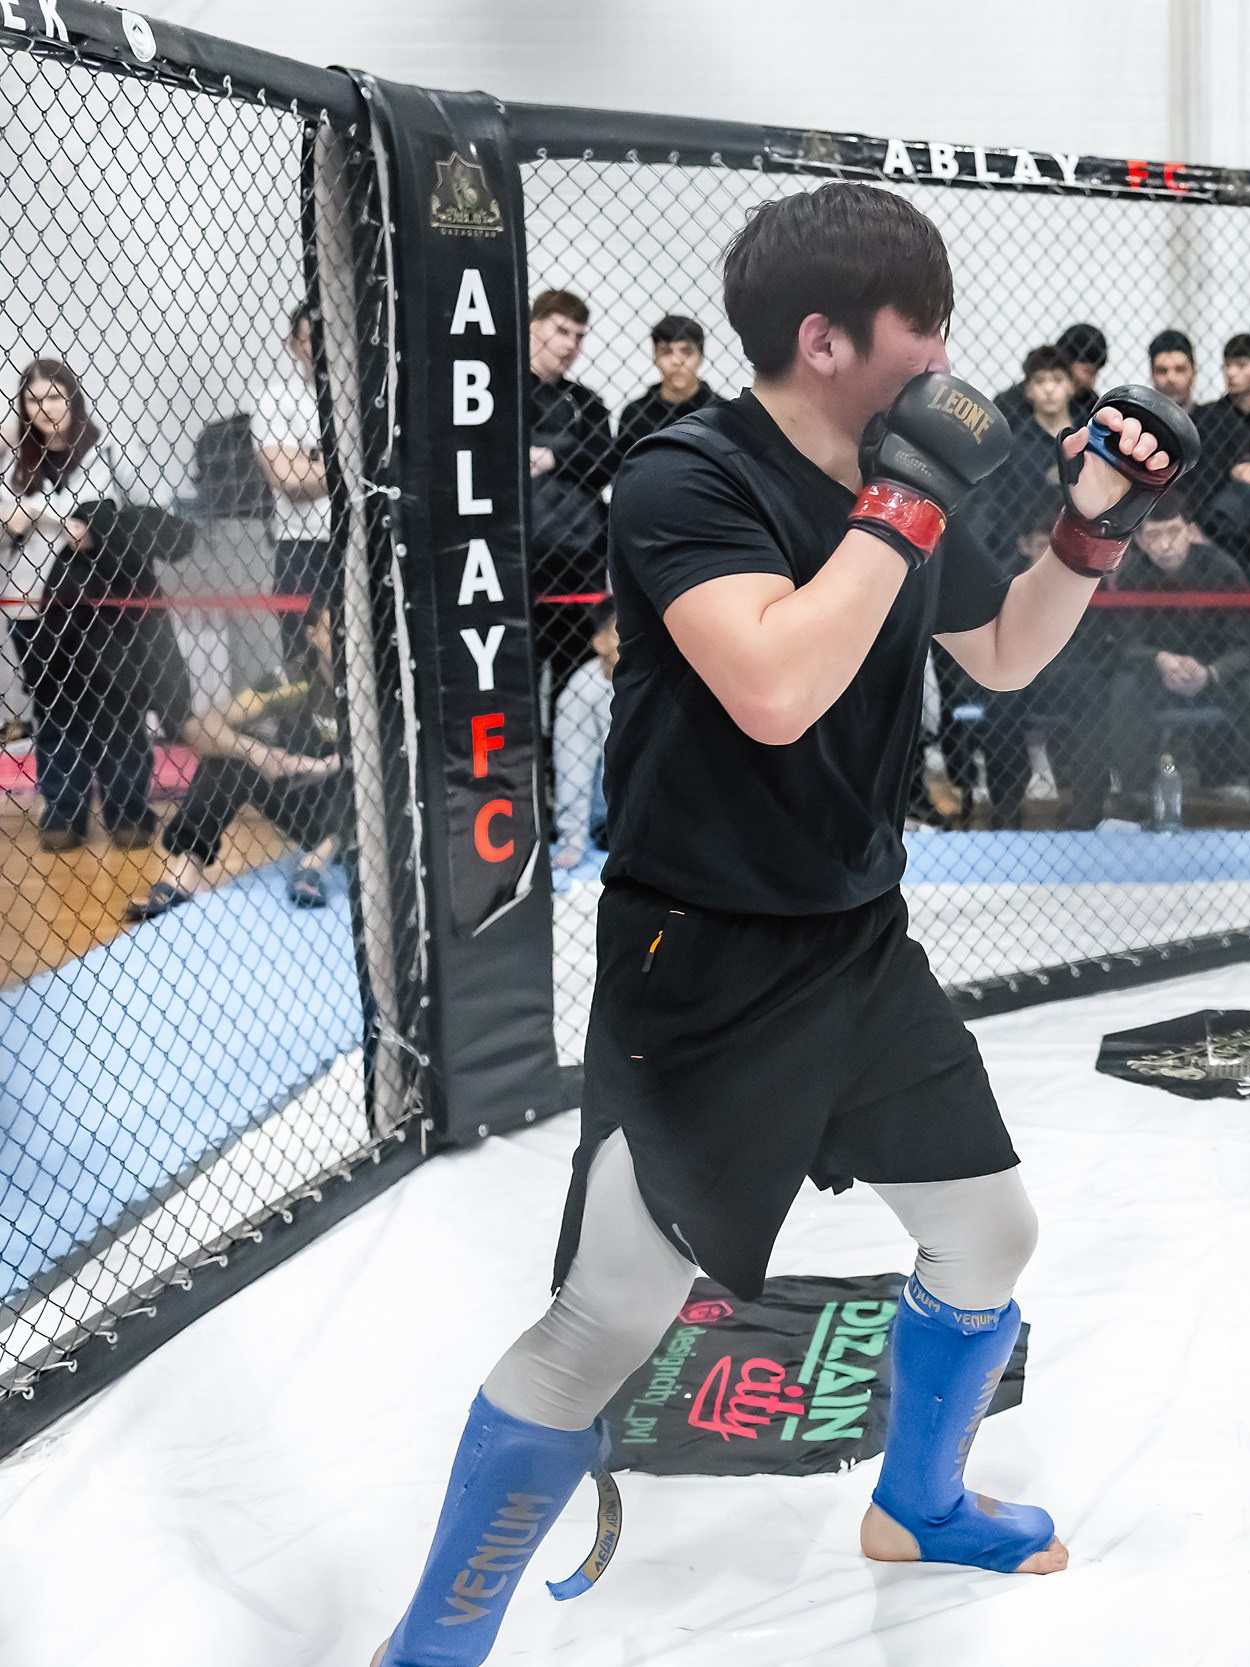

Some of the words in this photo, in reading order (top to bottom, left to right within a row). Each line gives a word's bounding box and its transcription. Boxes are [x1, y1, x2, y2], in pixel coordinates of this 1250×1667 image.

[882, 138, 1082, 186] ABLAY
[1126, 159, 1189, 192] FC
[450, 268, 505, 692] ABLAY
[927, 384, 996, 445] LEONE
[471, 712, 514, 863] FC
[802, 1301, 897, 1442] DIZAIN
[952, 1311, 998, 1329] VENUM
[435, 1493, 552, 1627] VENUM
